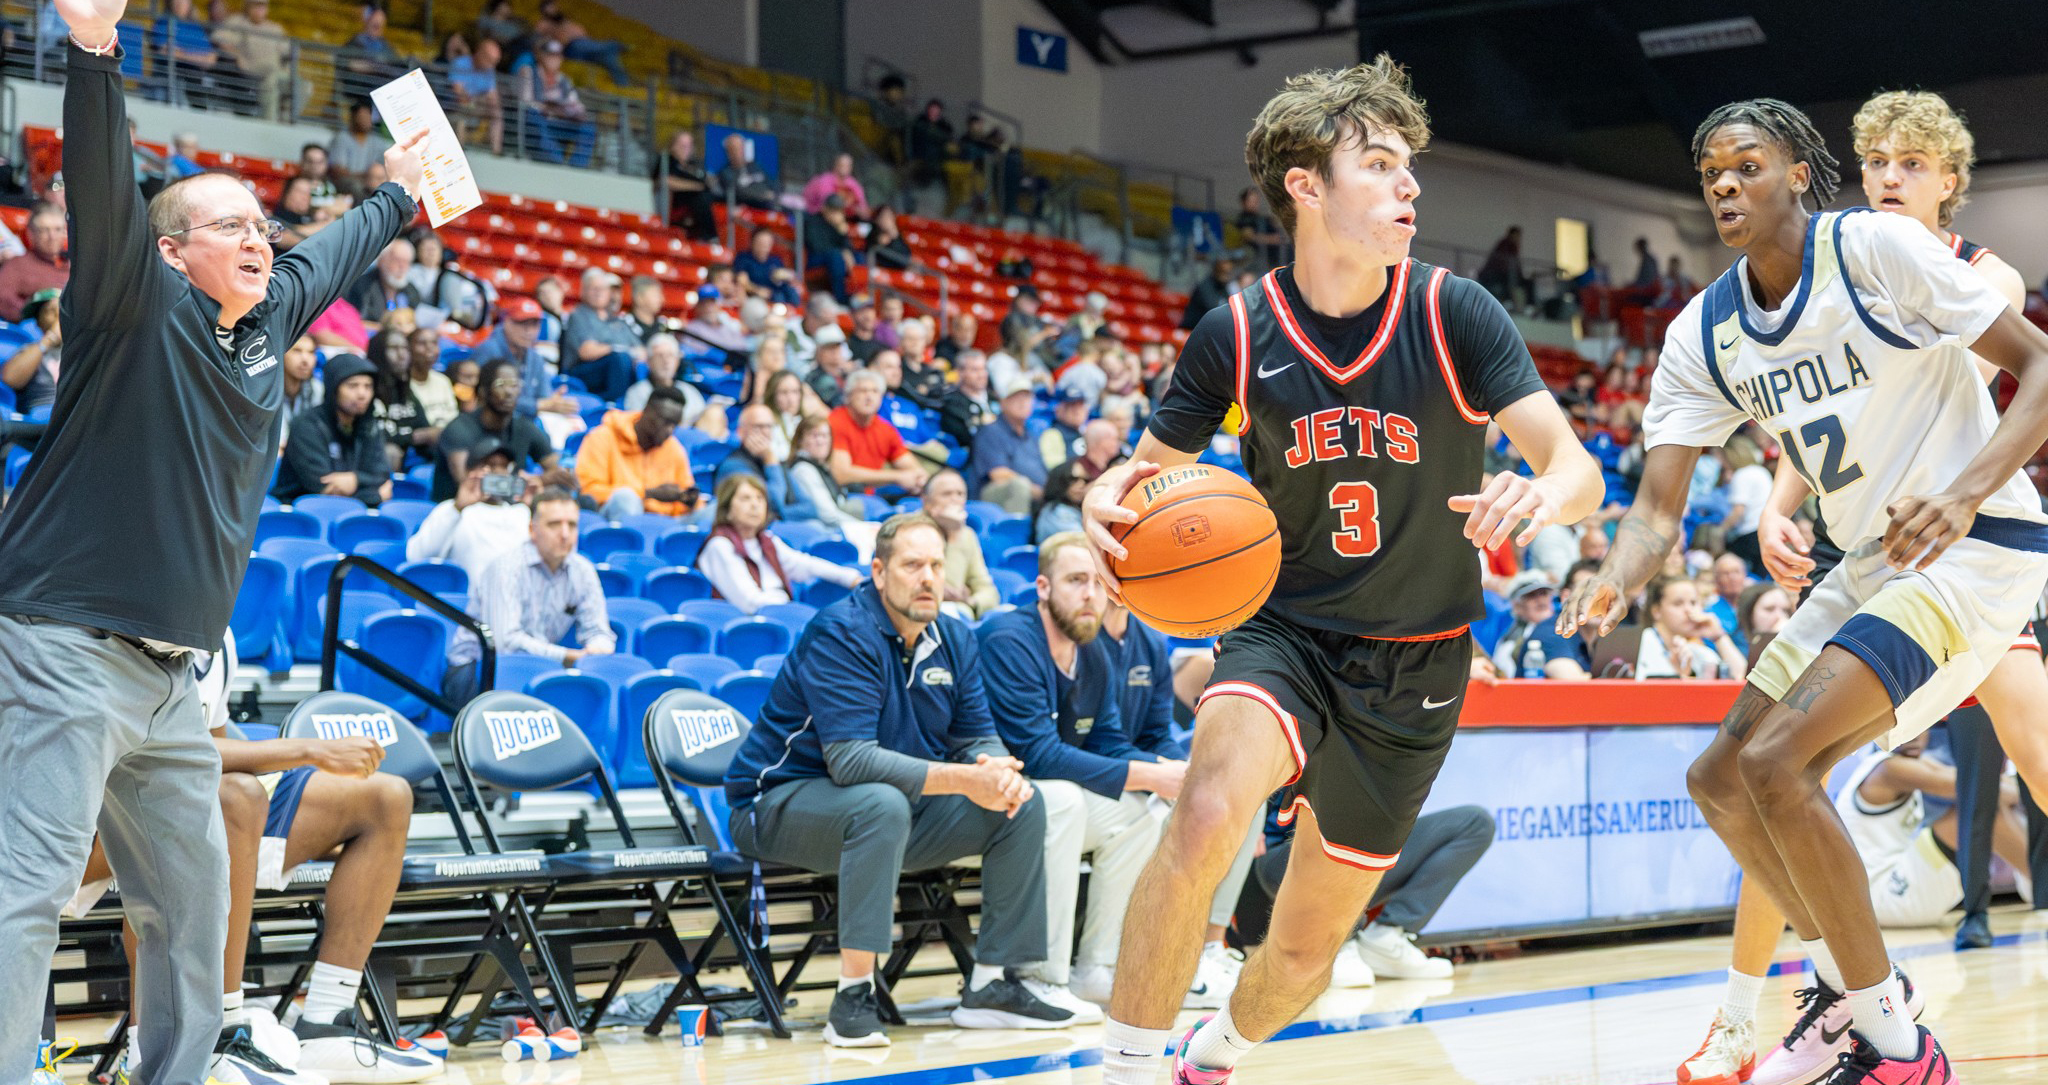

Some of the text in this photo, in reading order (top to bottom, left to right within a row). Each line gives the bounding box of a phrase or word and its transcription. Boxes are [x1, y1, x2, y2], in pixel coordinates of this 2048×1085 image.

[1030, 33, 1056, 65] Y
[1735, 341, 1870, 422] CHIPOLA
[1285, 406, 1420, 469] JETS
[1779, 414, 1866, 494] 12
[1329, 481, 1381, 557] 3
[489, 716, 556, 753] NJCAA
[677, 715, 733, 750] NJCAA
